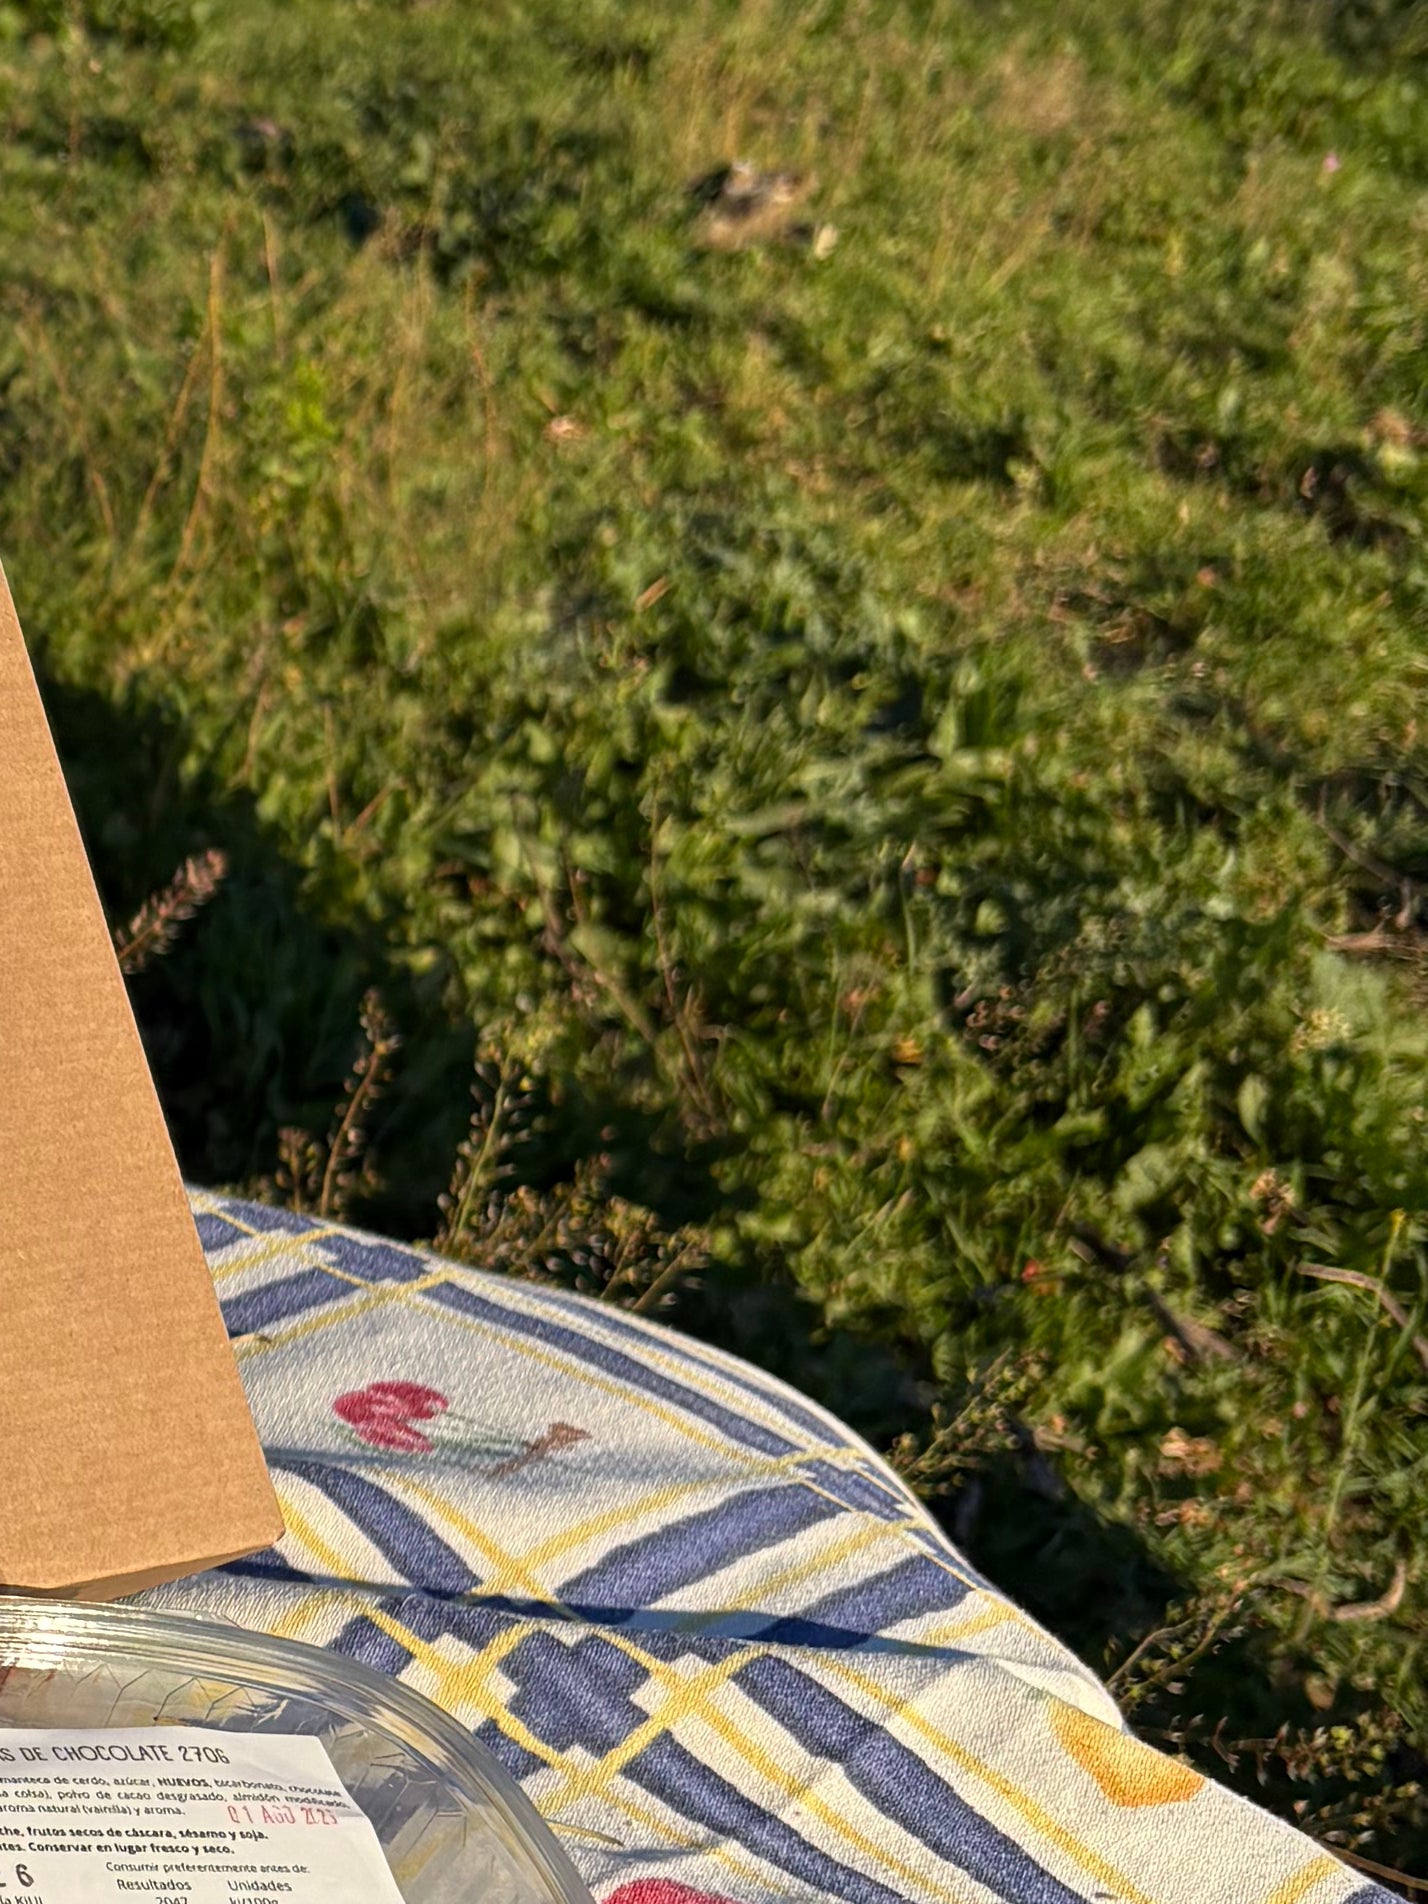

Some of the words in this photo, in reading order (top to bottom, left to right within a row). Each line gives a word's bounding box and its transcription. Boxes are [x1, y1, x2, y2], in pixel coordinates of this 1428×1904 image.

[19, 1746, 48, 1762] DE
[52, 1745, 174, 1762] CHOCOLATE
[179, 1746, 230, 1764] 2706
[106, 1828, 122, 1837] de
[29, 1842, 92, 1853] Conservar
[114, 1843, 147, 1855] lugar
[150, 1843, 189, 1853] fresco
[117, 1879, 192, 1891] Resultados
[227, 1880, 293, 1892] Unidades
